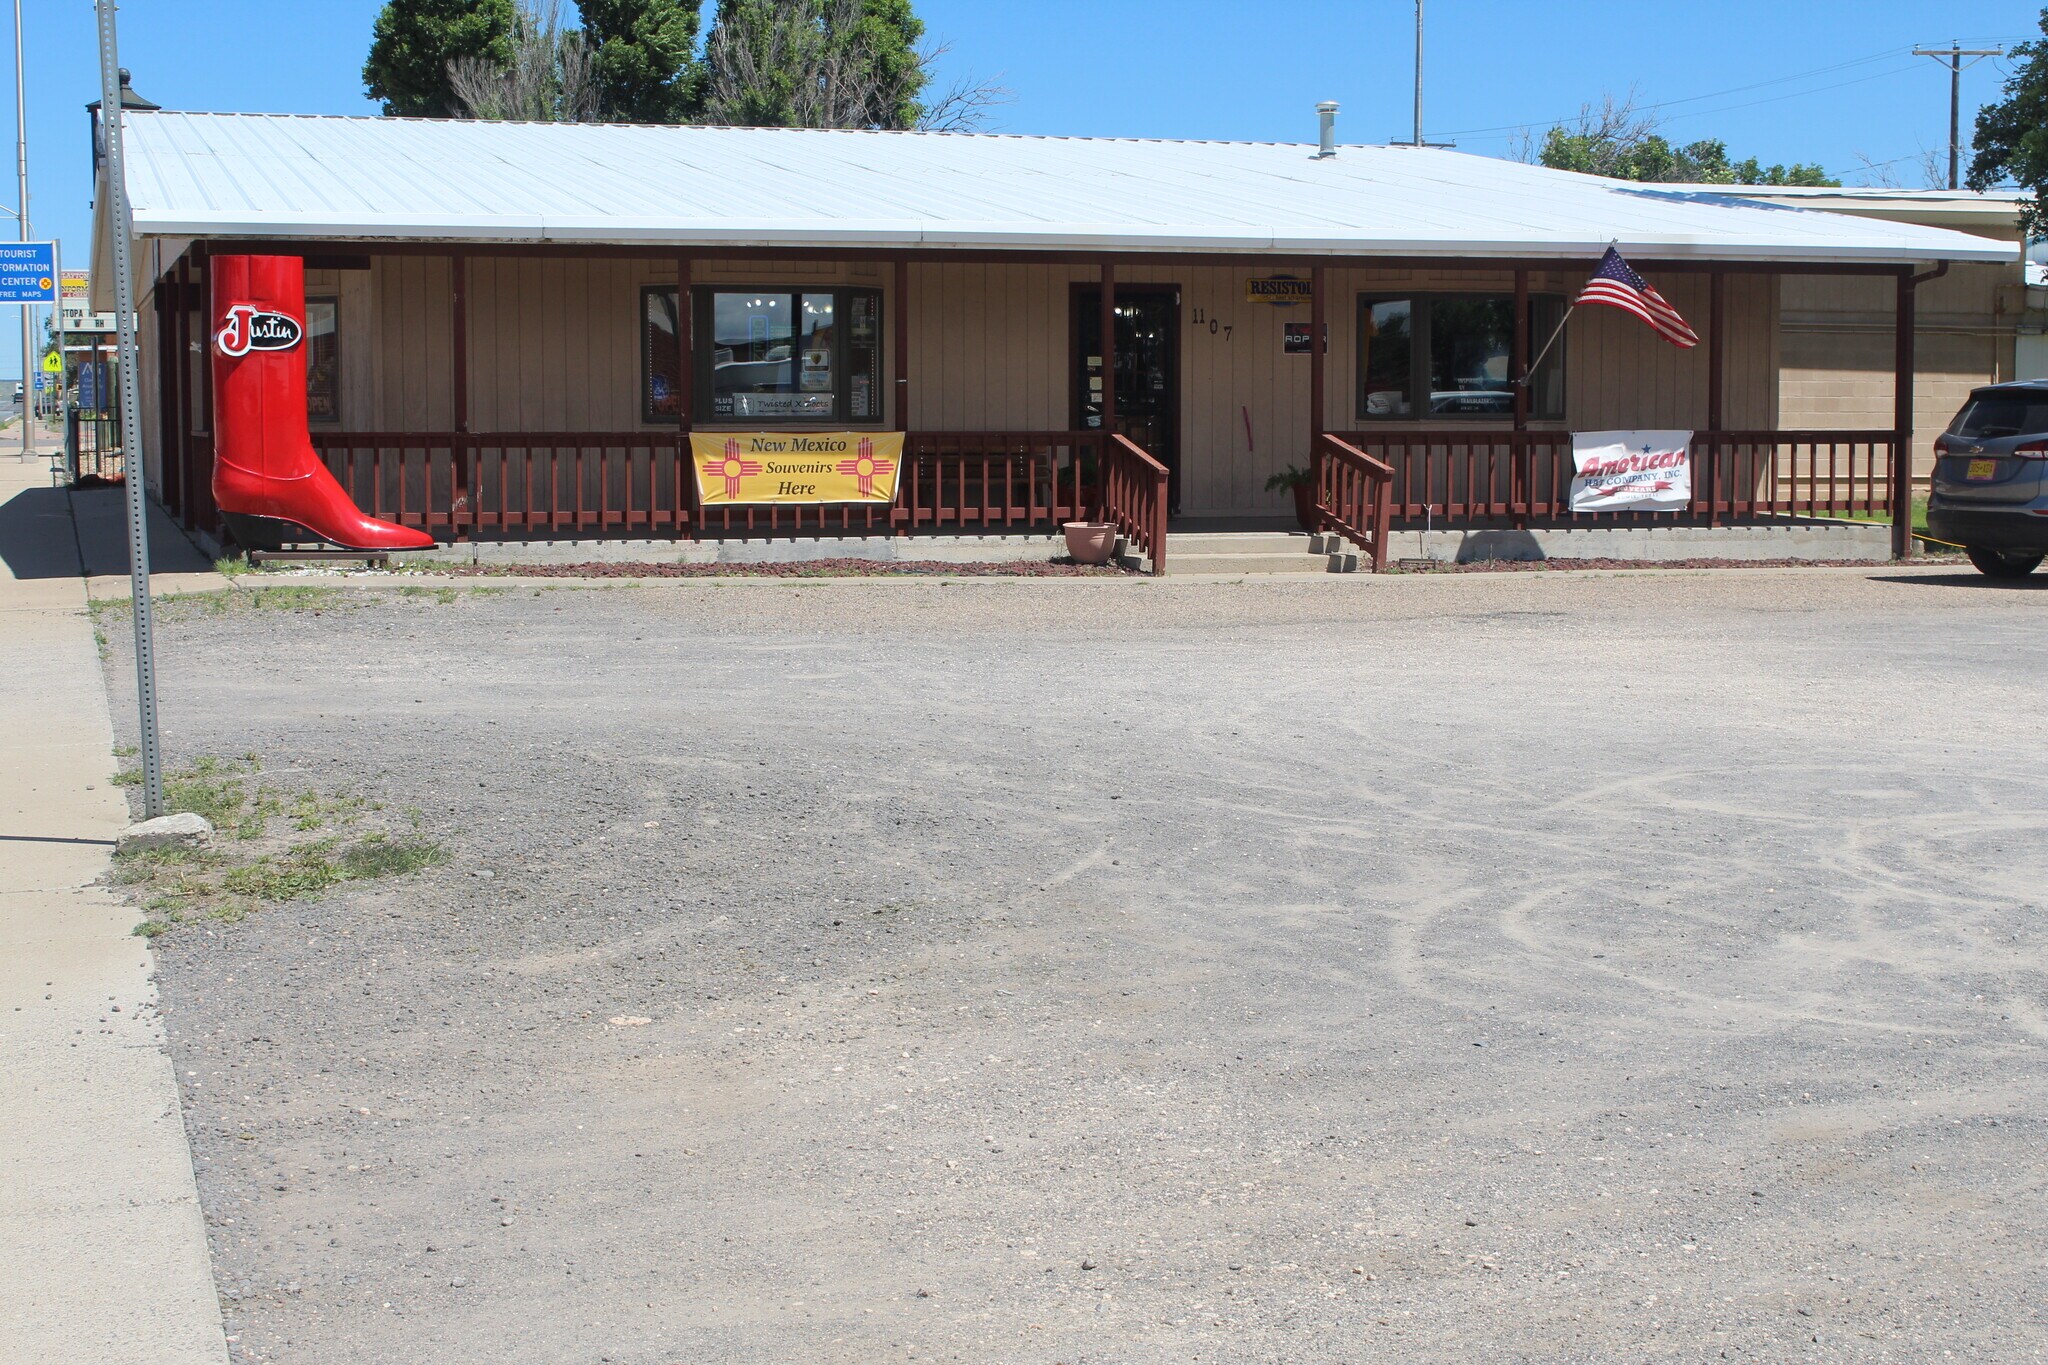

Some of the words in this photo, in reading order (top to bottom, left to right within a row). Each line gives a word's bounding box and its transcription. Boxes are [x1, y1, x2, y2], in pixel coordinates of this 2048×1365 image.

[0, 250, 36, 258] TOURIST
[2, 278, 37, 286] CENTER
[1250, 281, 1312, 295] RESISTOL
[218, 304, 294, 357] Justin
[1192, 308, 1232, 342] 1107
[1285, 335, 1327, 343] ROP
[758, 399, 792, 408] Twisted
[750, 438, 786, 453] New
[790, 437, 847, 452] Mexico
[765, 461, 833, 474] Souvenirs
[1578, 450, 1686, 479] American
[1663, 469, 1683, 480] INC.
[777, 481, 816, 495] Here
